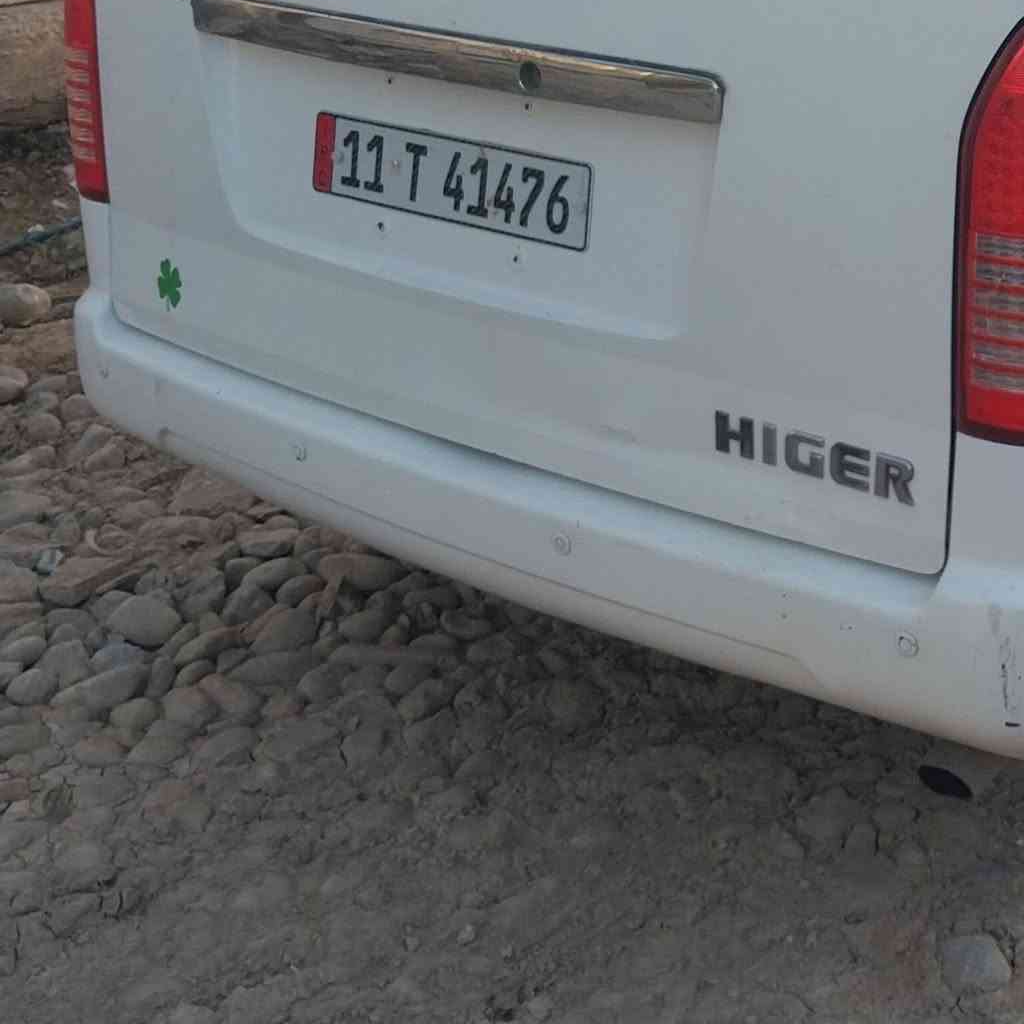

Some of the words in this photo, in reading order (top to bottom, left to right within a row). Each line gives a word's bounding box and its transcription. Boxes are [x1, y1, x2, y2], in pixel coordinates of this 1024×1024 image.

[340, 129, 384, 193] 11
[405, 142, 428, 202] T
[443, 151, 570, 235] 41476
[714, 409, 916, 507] HIGER
